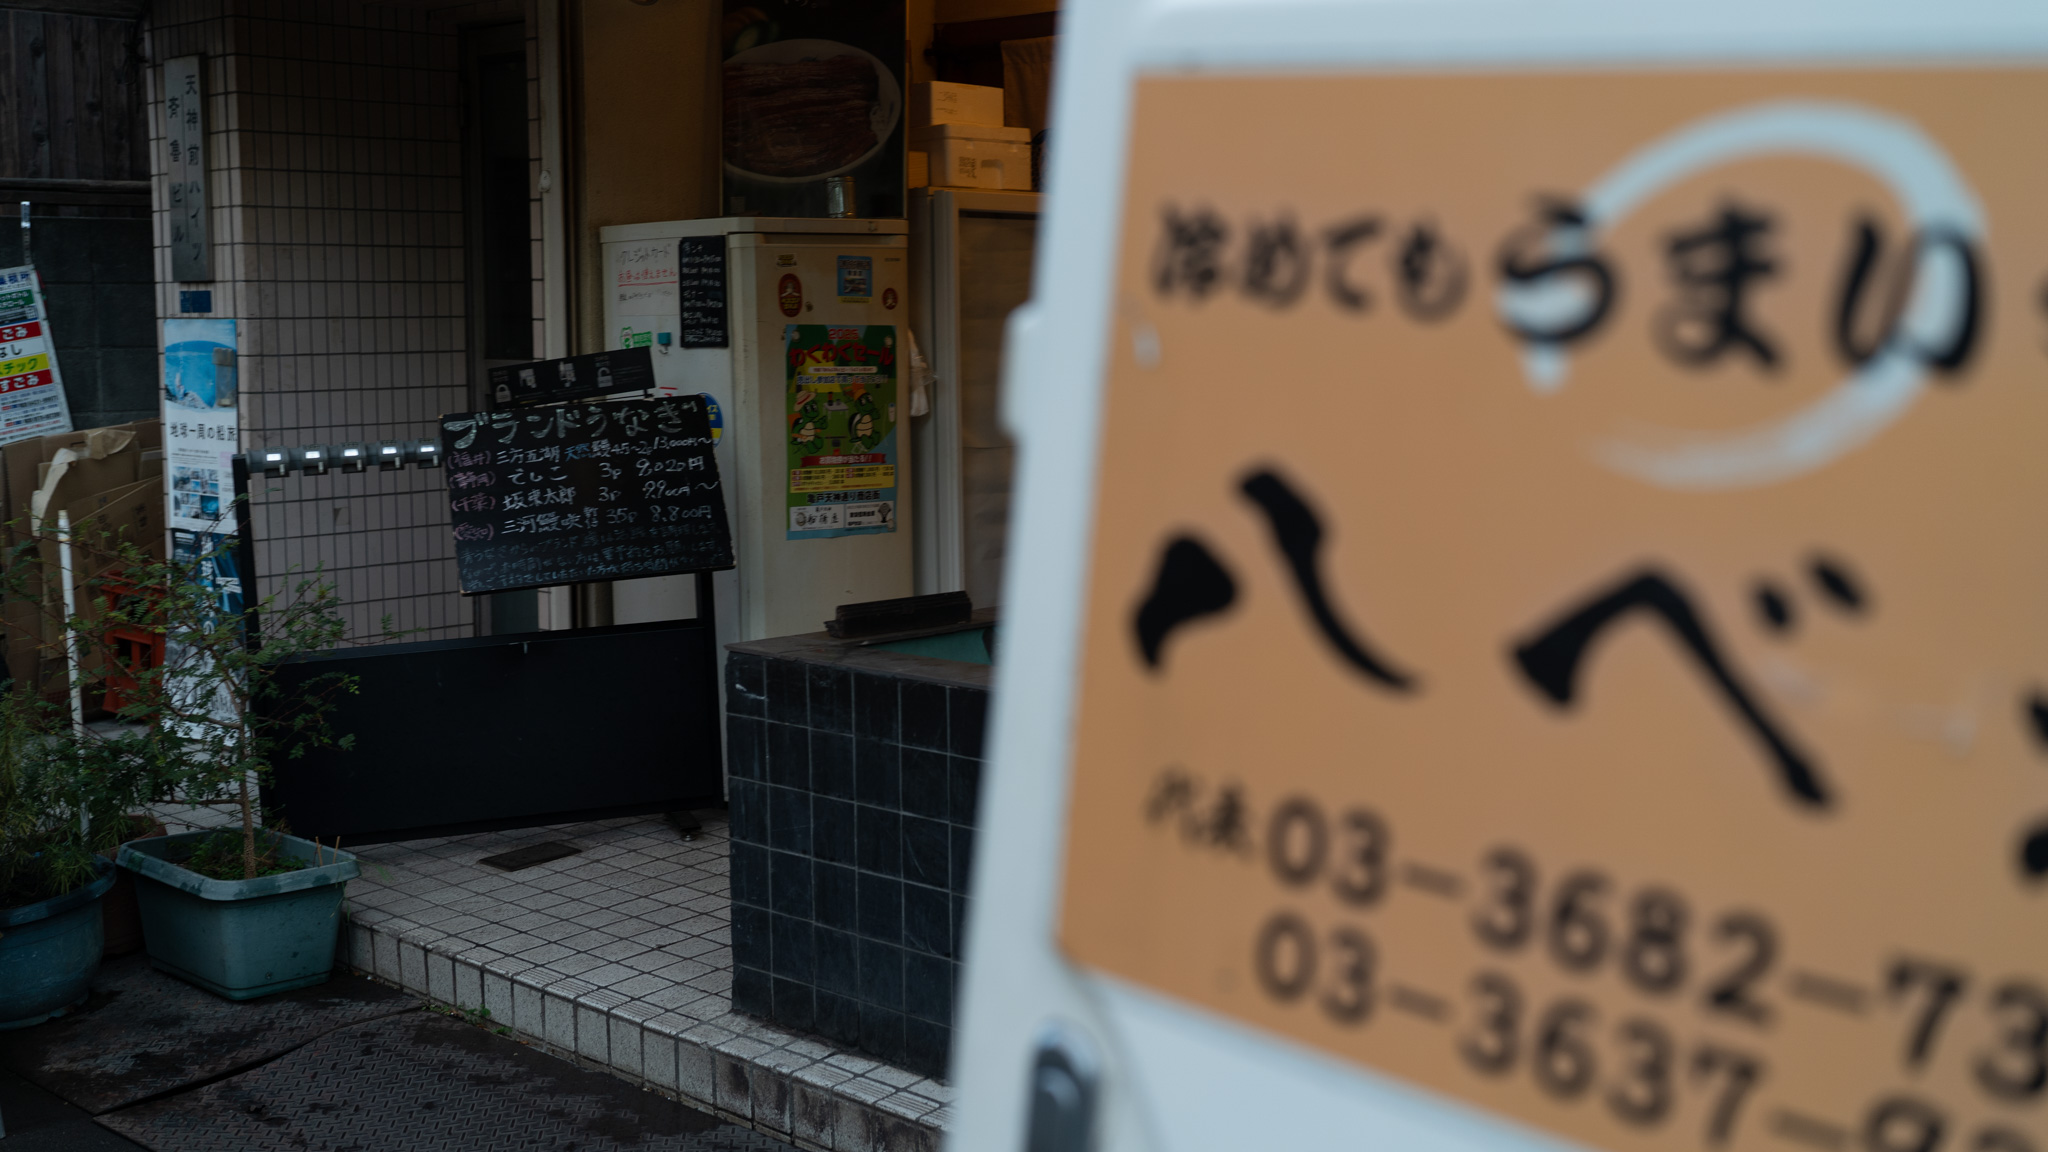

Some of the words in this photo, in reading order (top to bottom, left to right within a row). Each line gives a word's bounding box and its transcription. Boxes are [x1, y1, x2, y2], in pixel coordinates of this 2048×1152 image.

[0, 357, 38, 375] チック
[788, 342, 894, 367] わくわくセール
[170, 423, 238, 442] 地球一周の船旅
[443, 400, 698, 450] ブランドうなぎ
[501, 485, 577, 510] 坂東太郎
[1134, 466, 2048, 878] 八べ
